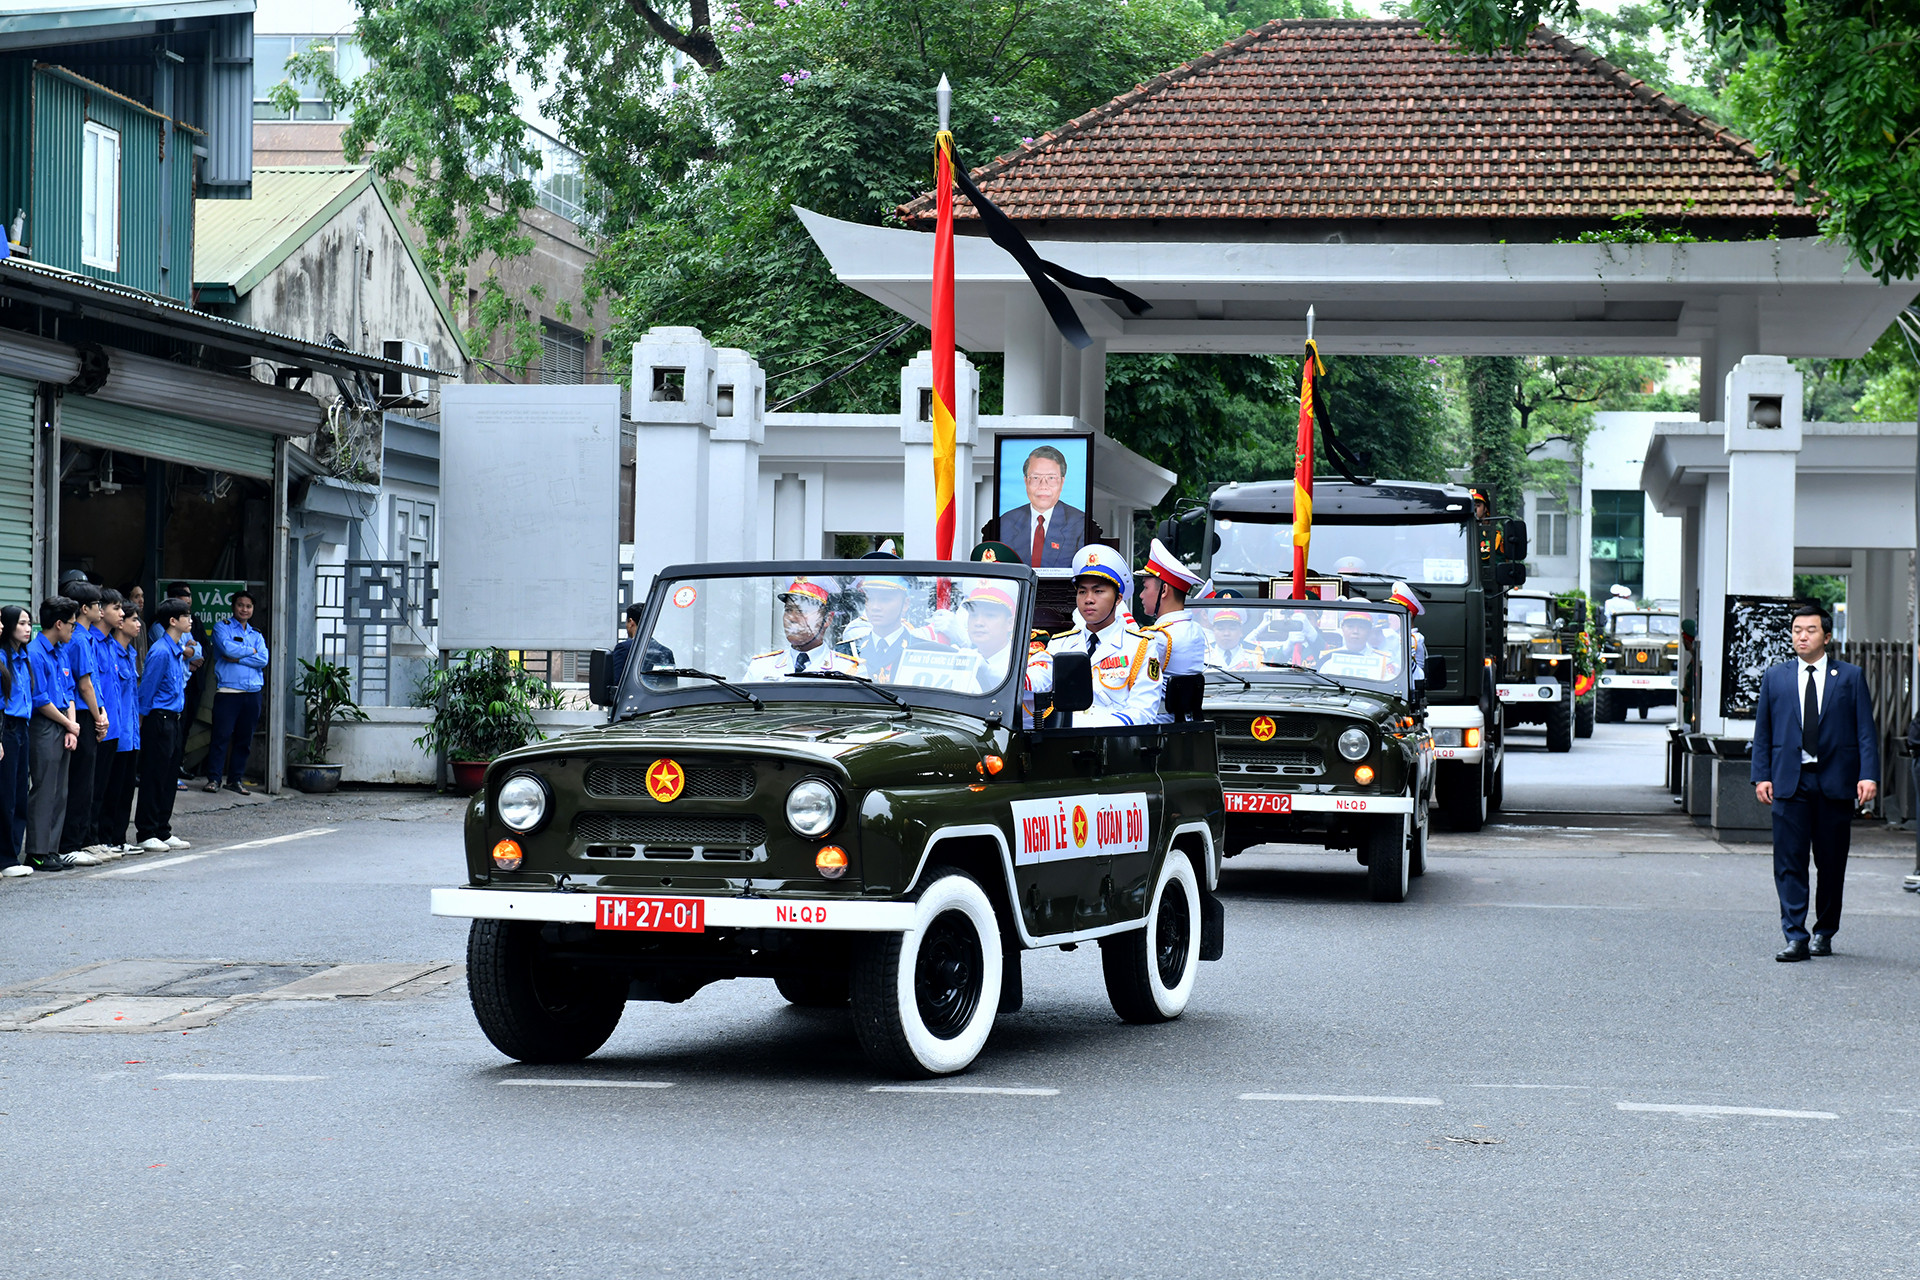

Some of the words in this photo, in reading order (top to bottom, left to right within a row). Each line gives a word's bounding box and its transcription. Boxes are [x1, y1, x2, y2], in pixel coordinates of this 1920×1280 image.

[1433, 570, 1454, 581] 06
[1225, 794, 1290, 812] TM-27-02
[1336, 800, 1367, 810] NLQĐ
[1023, 816, 1050, 853] NGHI
[1054, 801, 1067, 849] LỄ
[1097, 804, 1122, 849] QUÂN
[1127, 802, 1143, 850] ĐỘI
[600, 899, 698, 930] TM-27-01
[776, 905, 827, 923] NLQĐ
